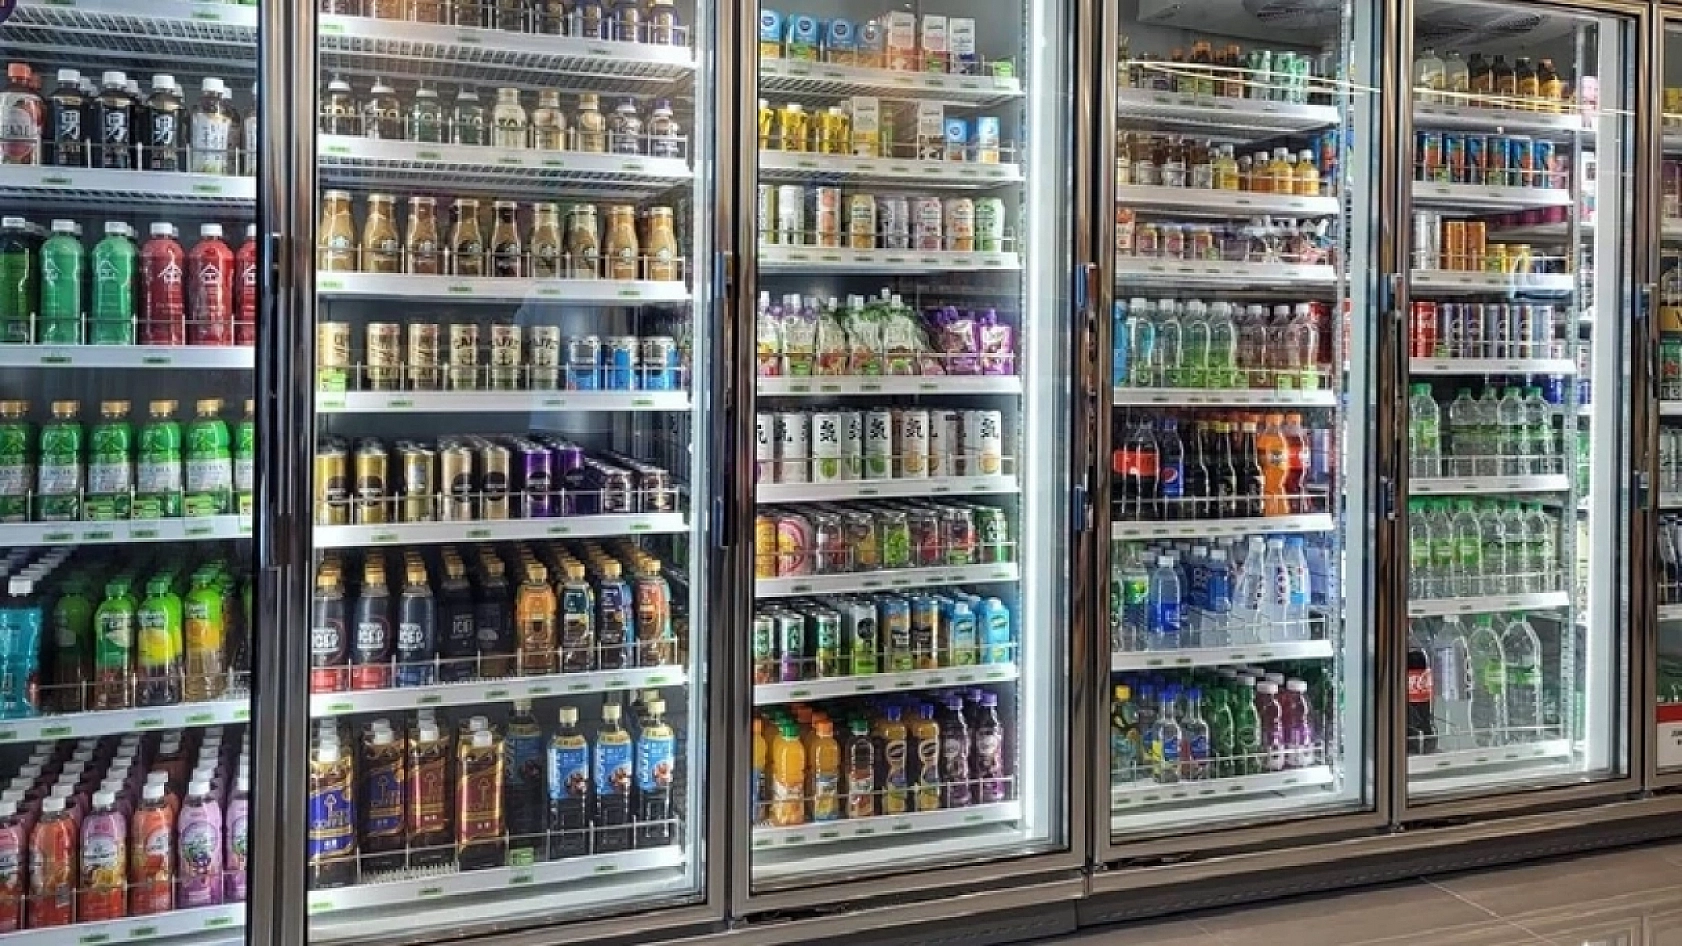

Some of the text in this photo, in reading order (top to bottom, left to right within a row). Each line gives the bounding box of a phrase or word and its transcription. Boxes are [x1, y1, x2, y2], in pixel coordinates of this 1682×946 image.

[61, 110, 80, 140] 男
[106, 112, 128, 141] 男
[155, 114, 173, 144] 男
